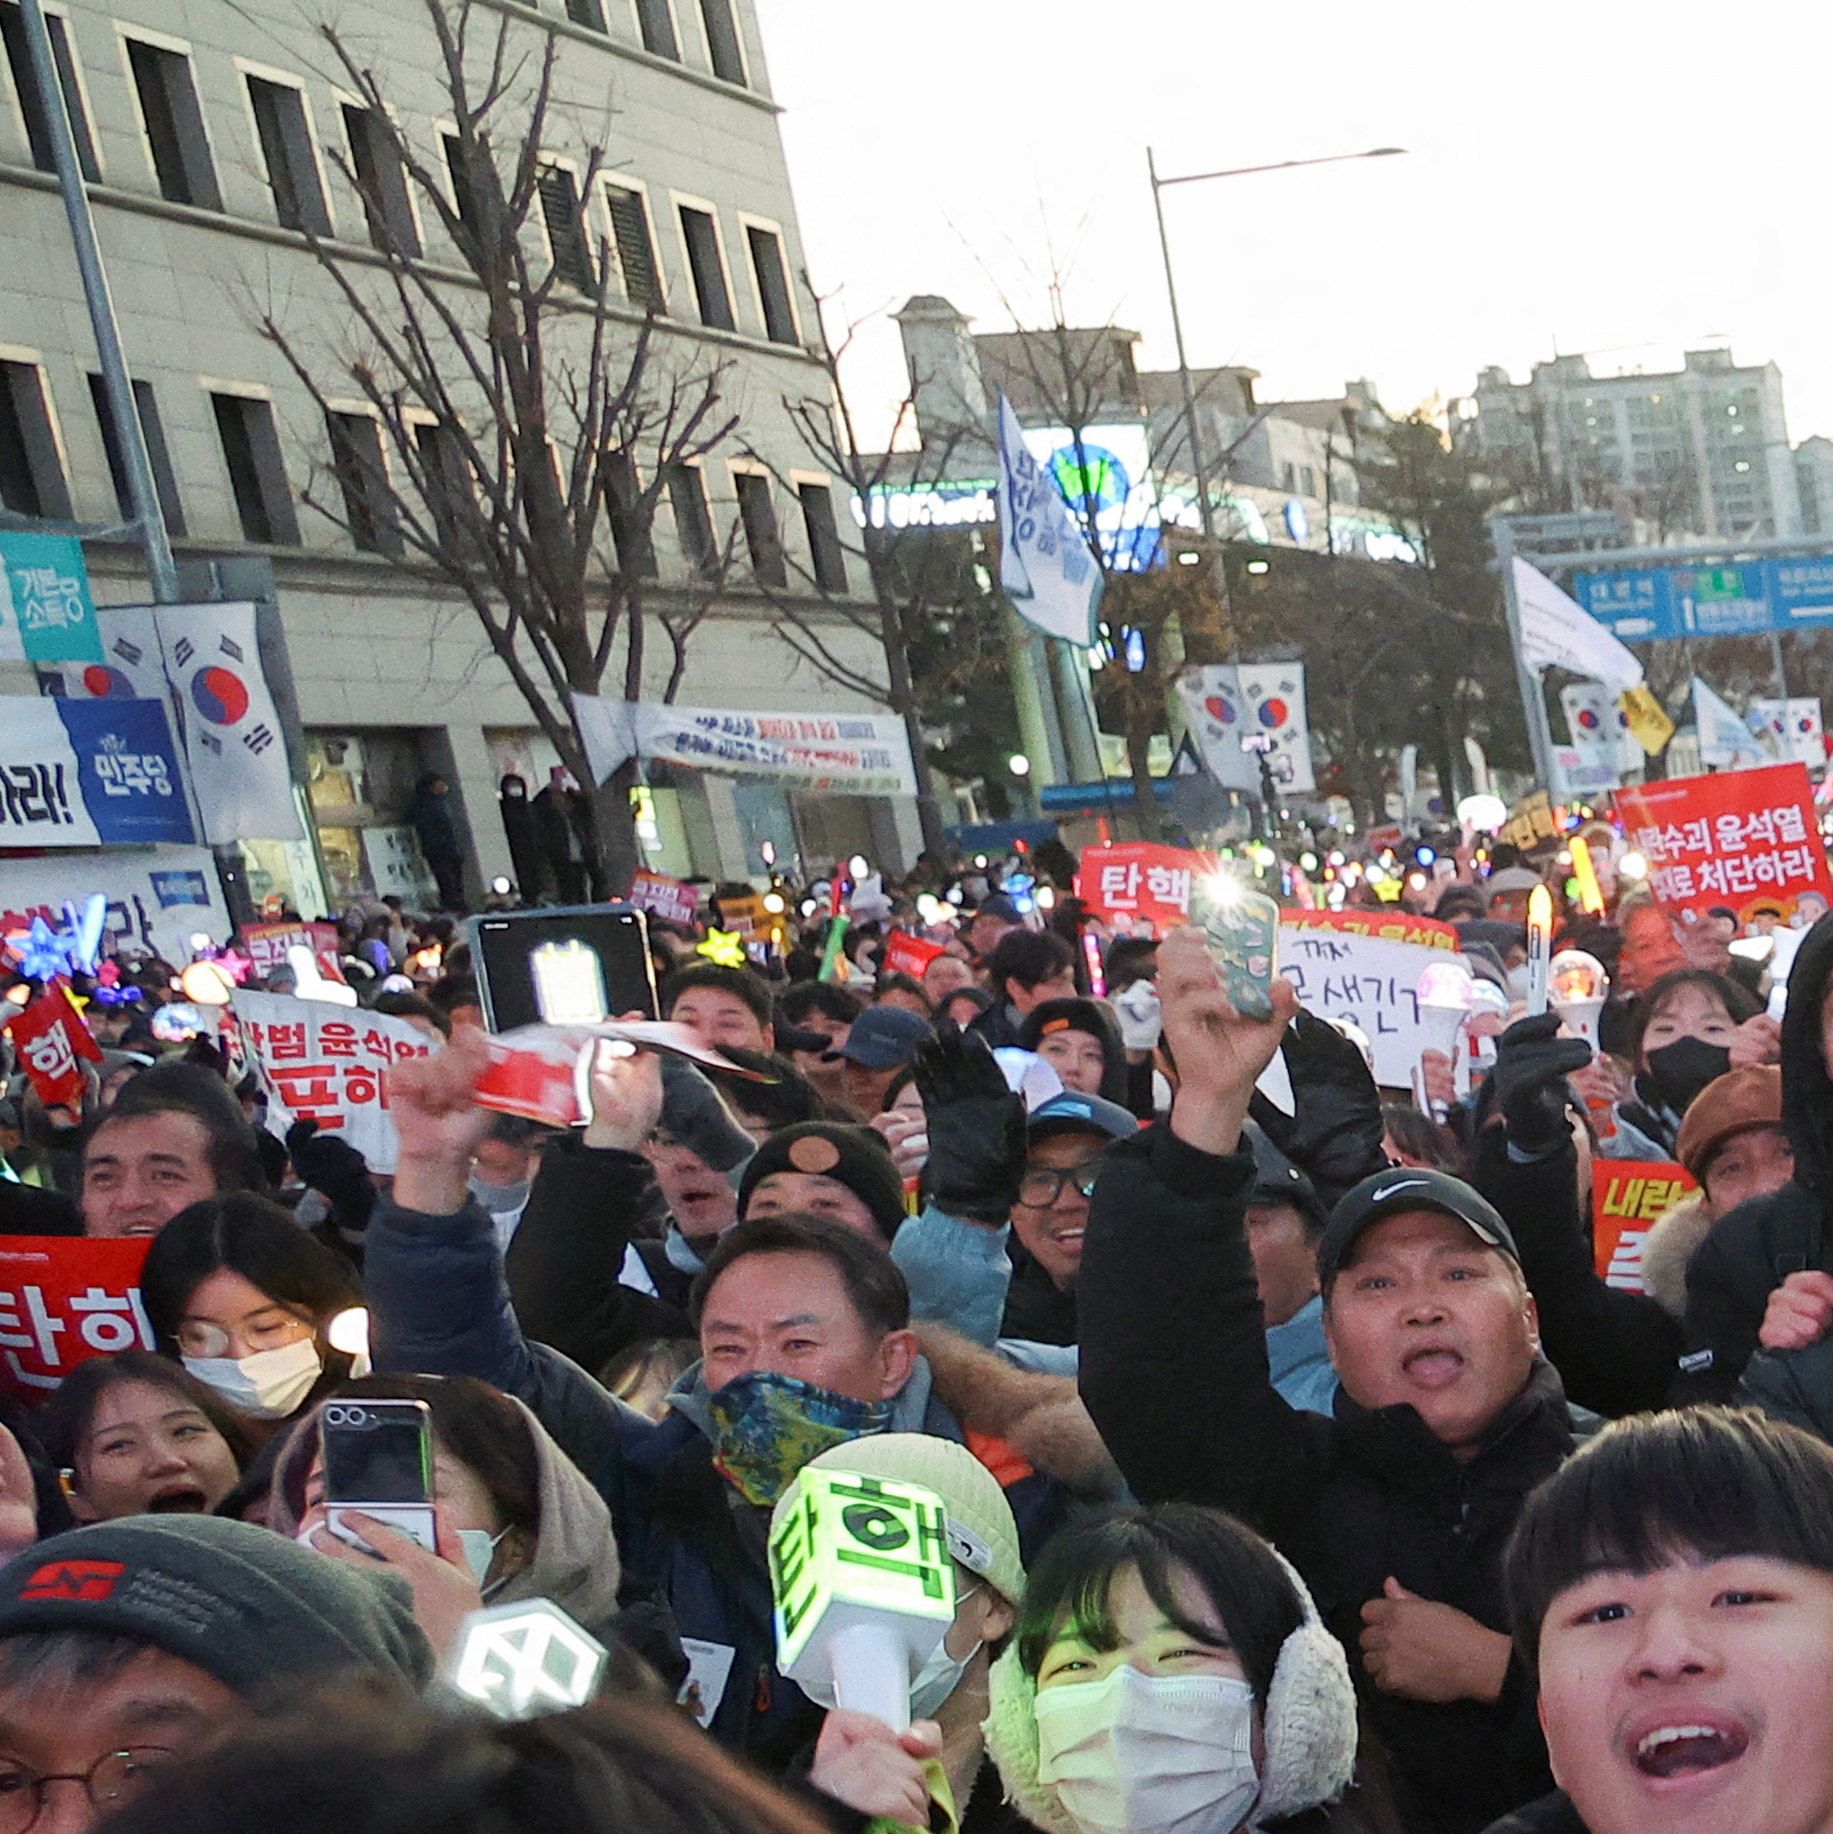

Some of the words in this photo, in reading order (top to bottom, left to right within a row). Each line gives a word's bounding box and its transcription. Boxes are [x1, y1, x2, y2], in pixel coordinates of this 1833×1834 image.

[95, 753, 173, 797] 민주당
[1637, 816, 1713, 863] 란수괴
[1715, 804, 1807, 852] 윤석열
[1101, 860, 1191, 915] 탄핵
[1697, 845, 1815, 895] 처단하라
